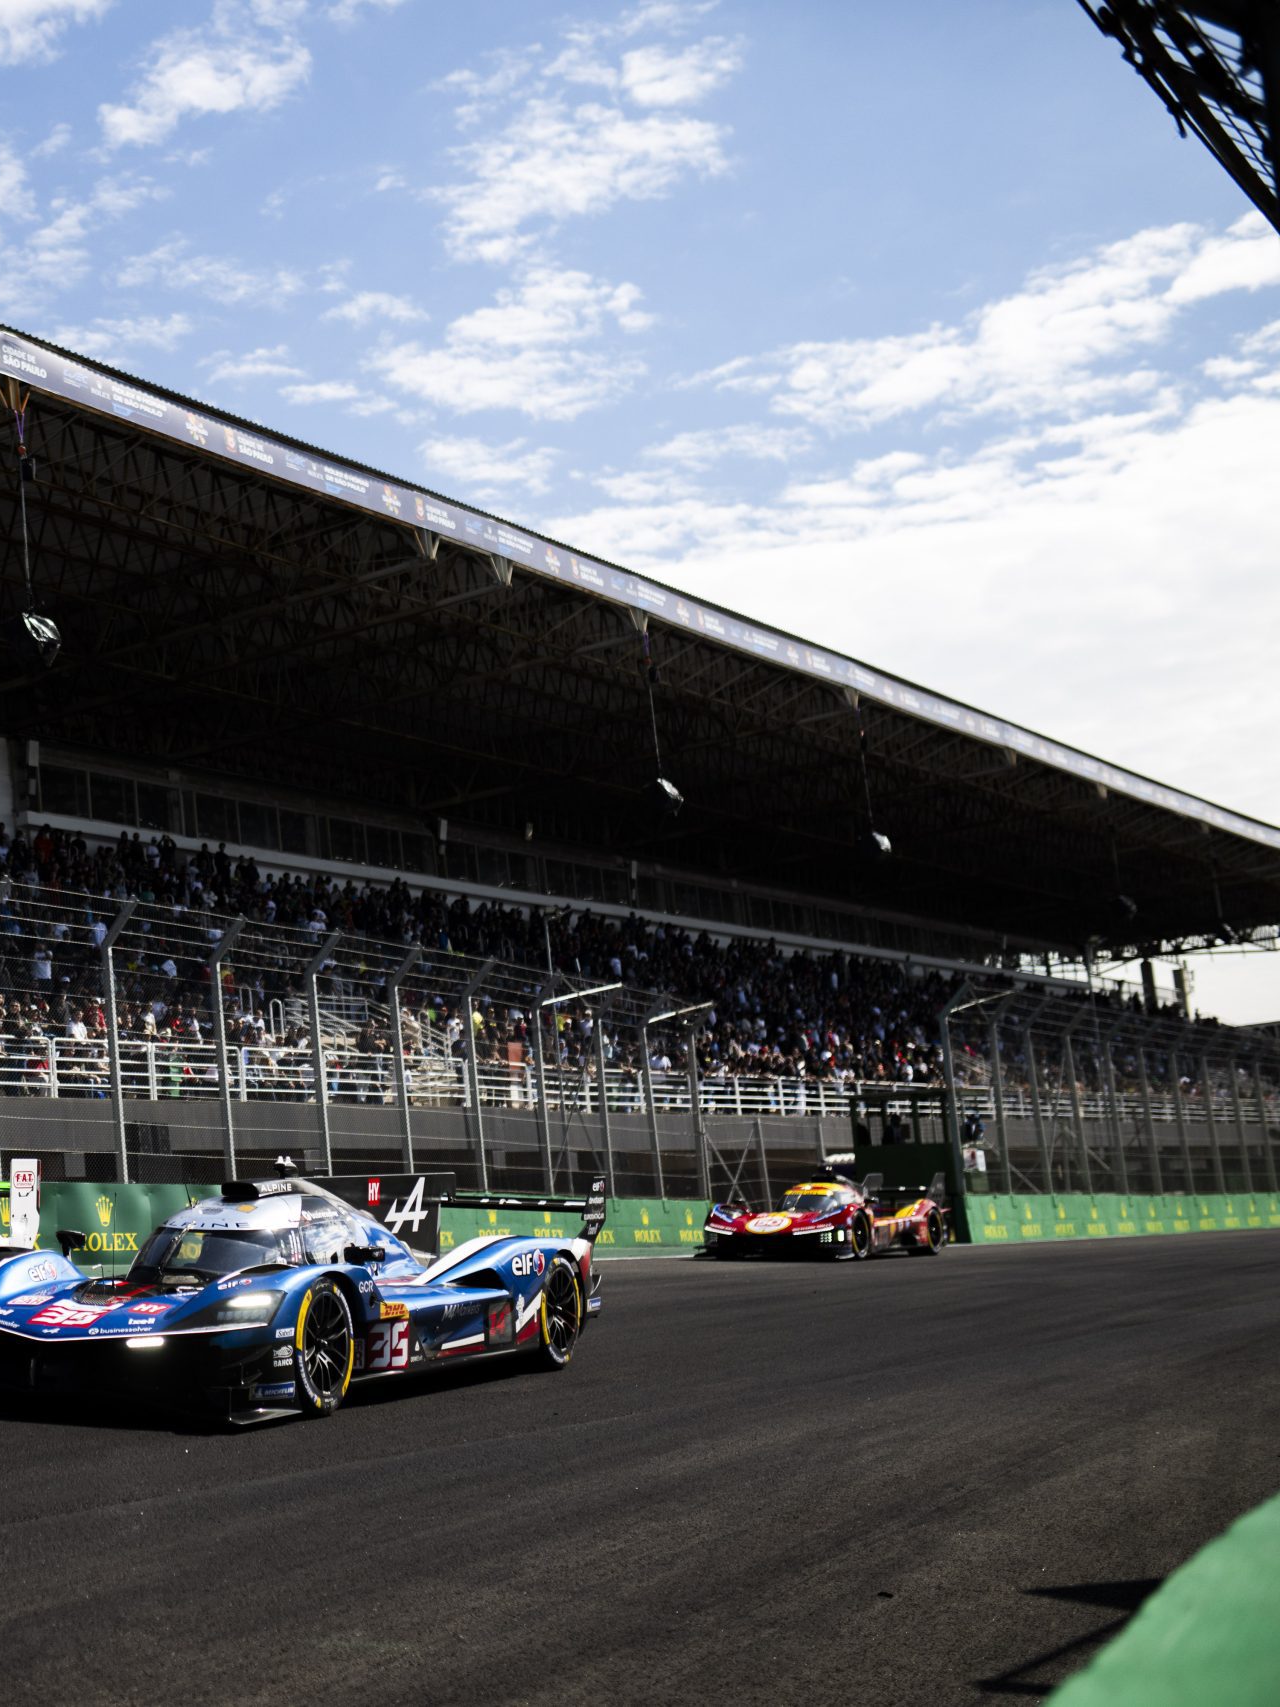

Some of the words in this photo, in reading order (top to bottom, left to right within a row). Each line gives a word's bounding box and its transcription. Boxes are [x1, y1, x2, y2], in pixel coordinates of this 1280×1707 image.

[21, 360, 48, 379] PAULO
[261, 1183, 292, 1192] ALPINE
[368, 1182, 380, 1202] HY
[634, 1230, 662, 1244] ROLEX
[679, 1230, 704, 1244] ROLEX
[511, 1253, 533, 1276] elf
[28, 1262, 48, 1283] elf
[217, 1281, 239, 1290] elf
[359, 1280, 374, 1294] GCR
[133, 1303, 168, 1315] HY
[384, 1304, 407, 1316] DHL
[99, 1326, 153, 1334] businessolver
[370, 1321, 409, 1368] 35
